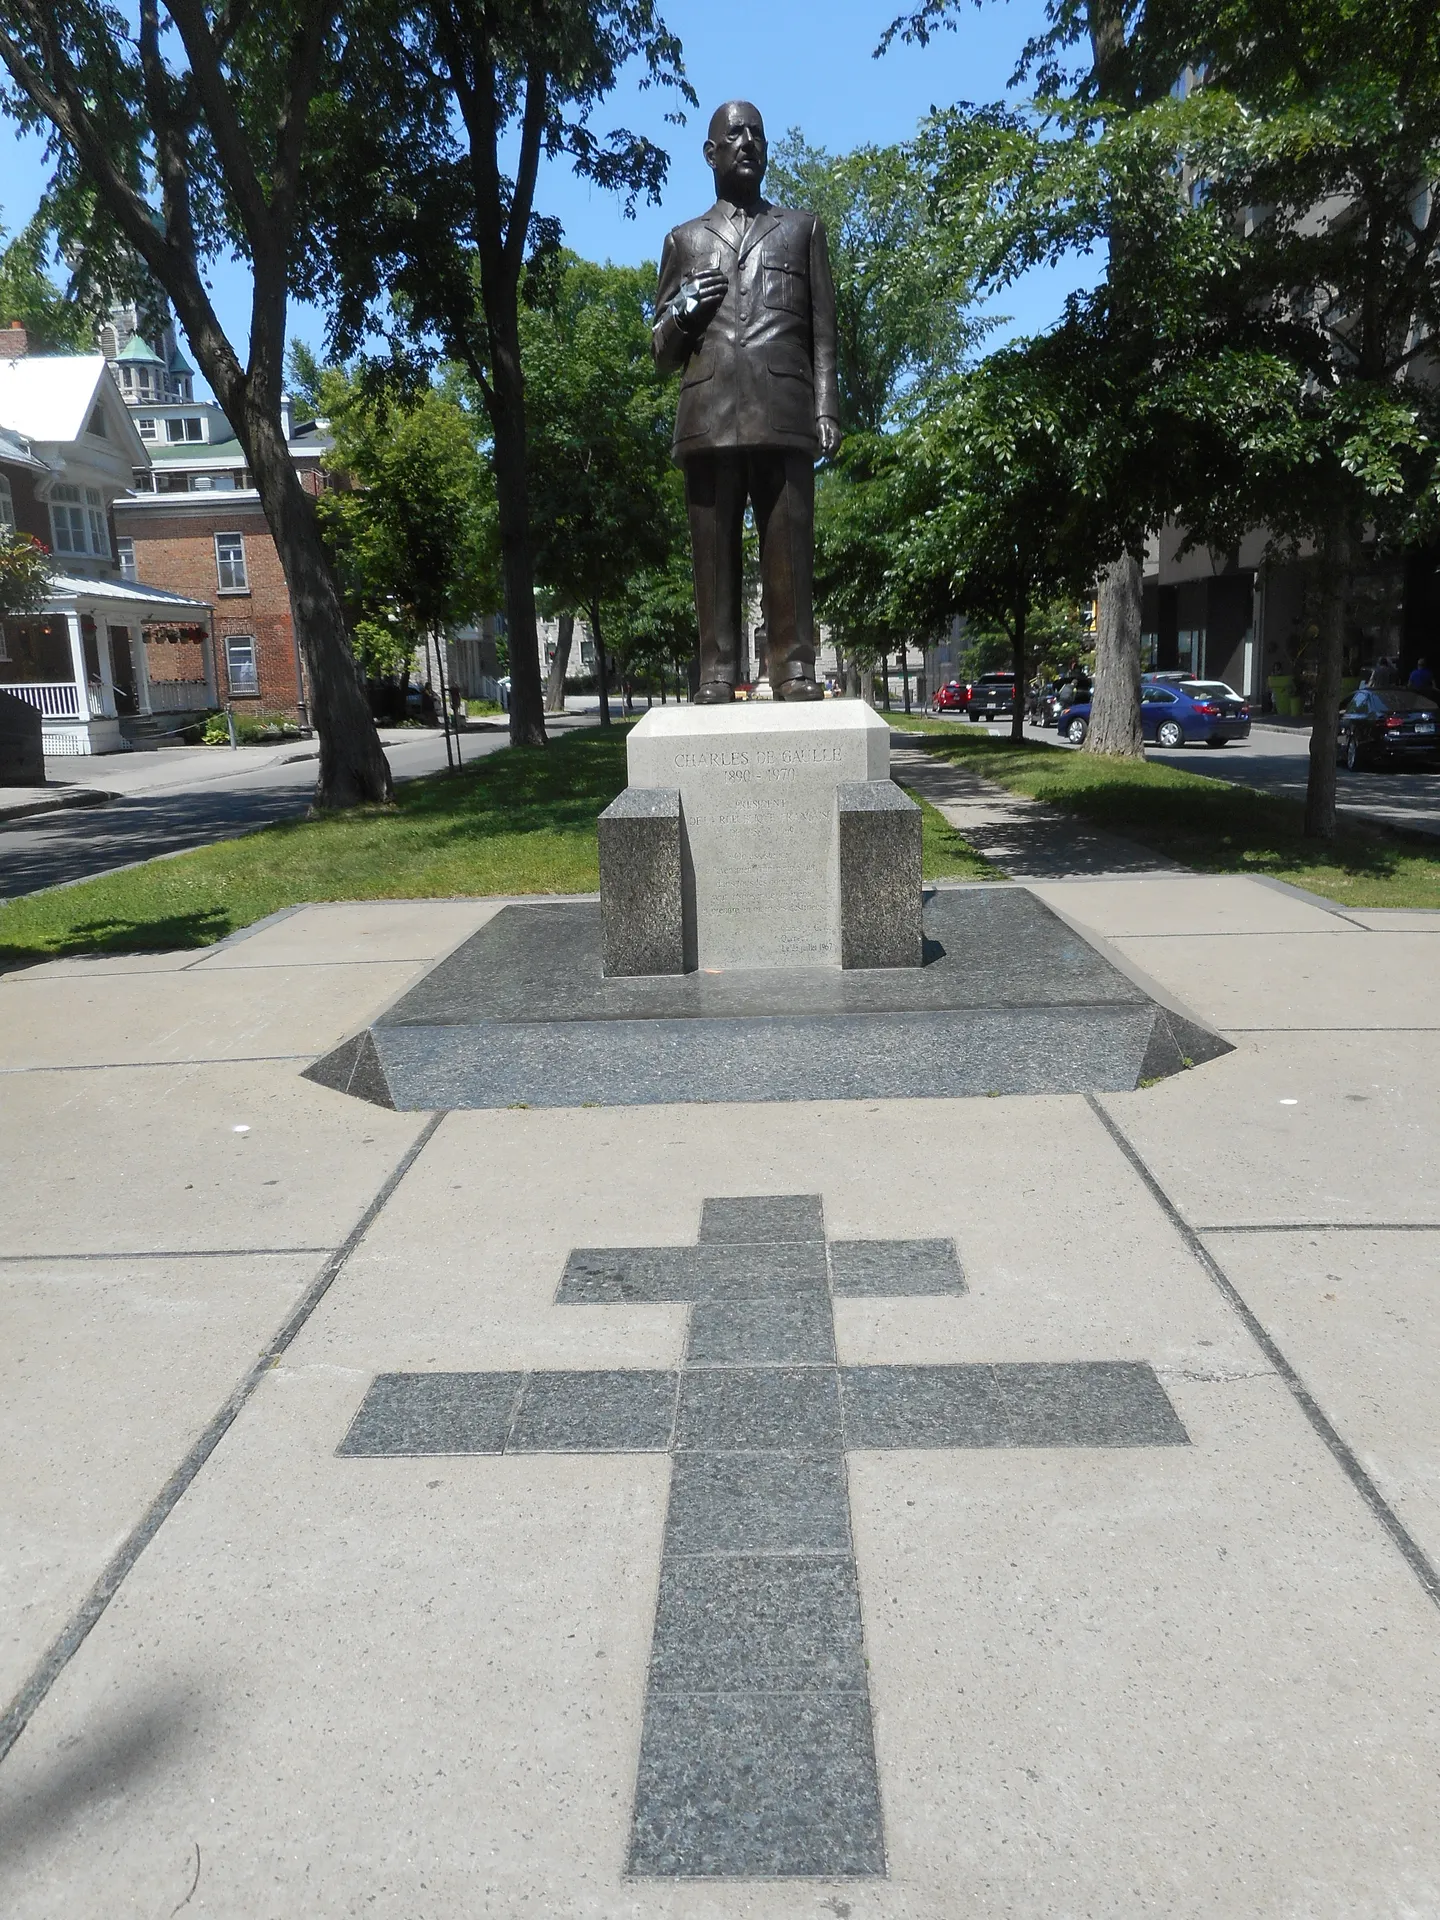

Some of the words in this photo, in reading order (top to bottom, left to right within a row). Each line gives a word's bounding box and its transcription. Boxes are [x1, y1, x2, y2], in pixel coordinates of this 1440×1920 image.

[674, 751, 749, 768] CHARLES
[756, 750, 775, 765] DE
[782, 748, 842, 764] GAULLE
[724, 769, 751, 784] 1890
[767, 768, 795, 783] 1970
